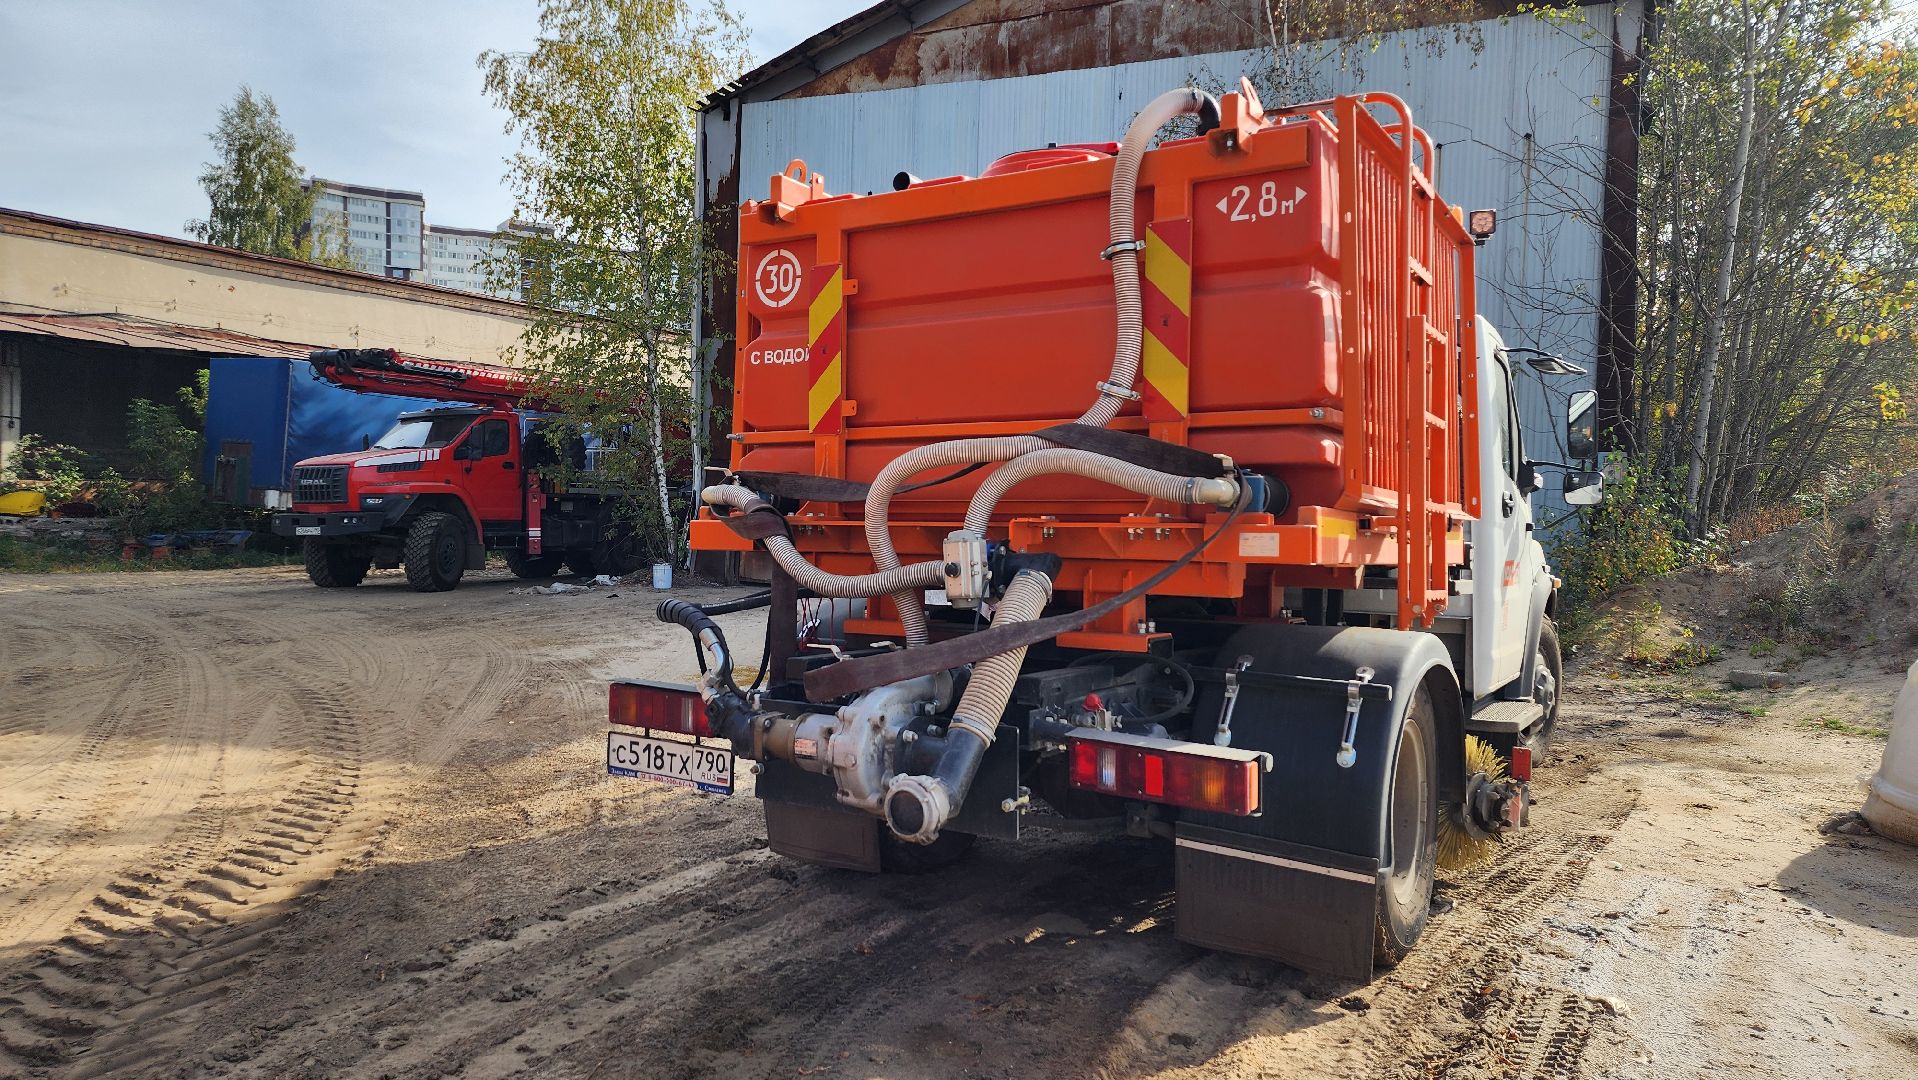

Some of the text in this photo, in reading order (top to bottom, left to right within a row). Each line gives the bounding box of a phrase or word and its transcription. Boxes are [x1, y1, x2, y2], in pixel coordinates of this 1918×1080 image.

[766, 264, 794, 294] 30
[750, 351, 761, 365] С
[695, 749, 726, 774] 790
[701, 772, 717, 782] RUS
